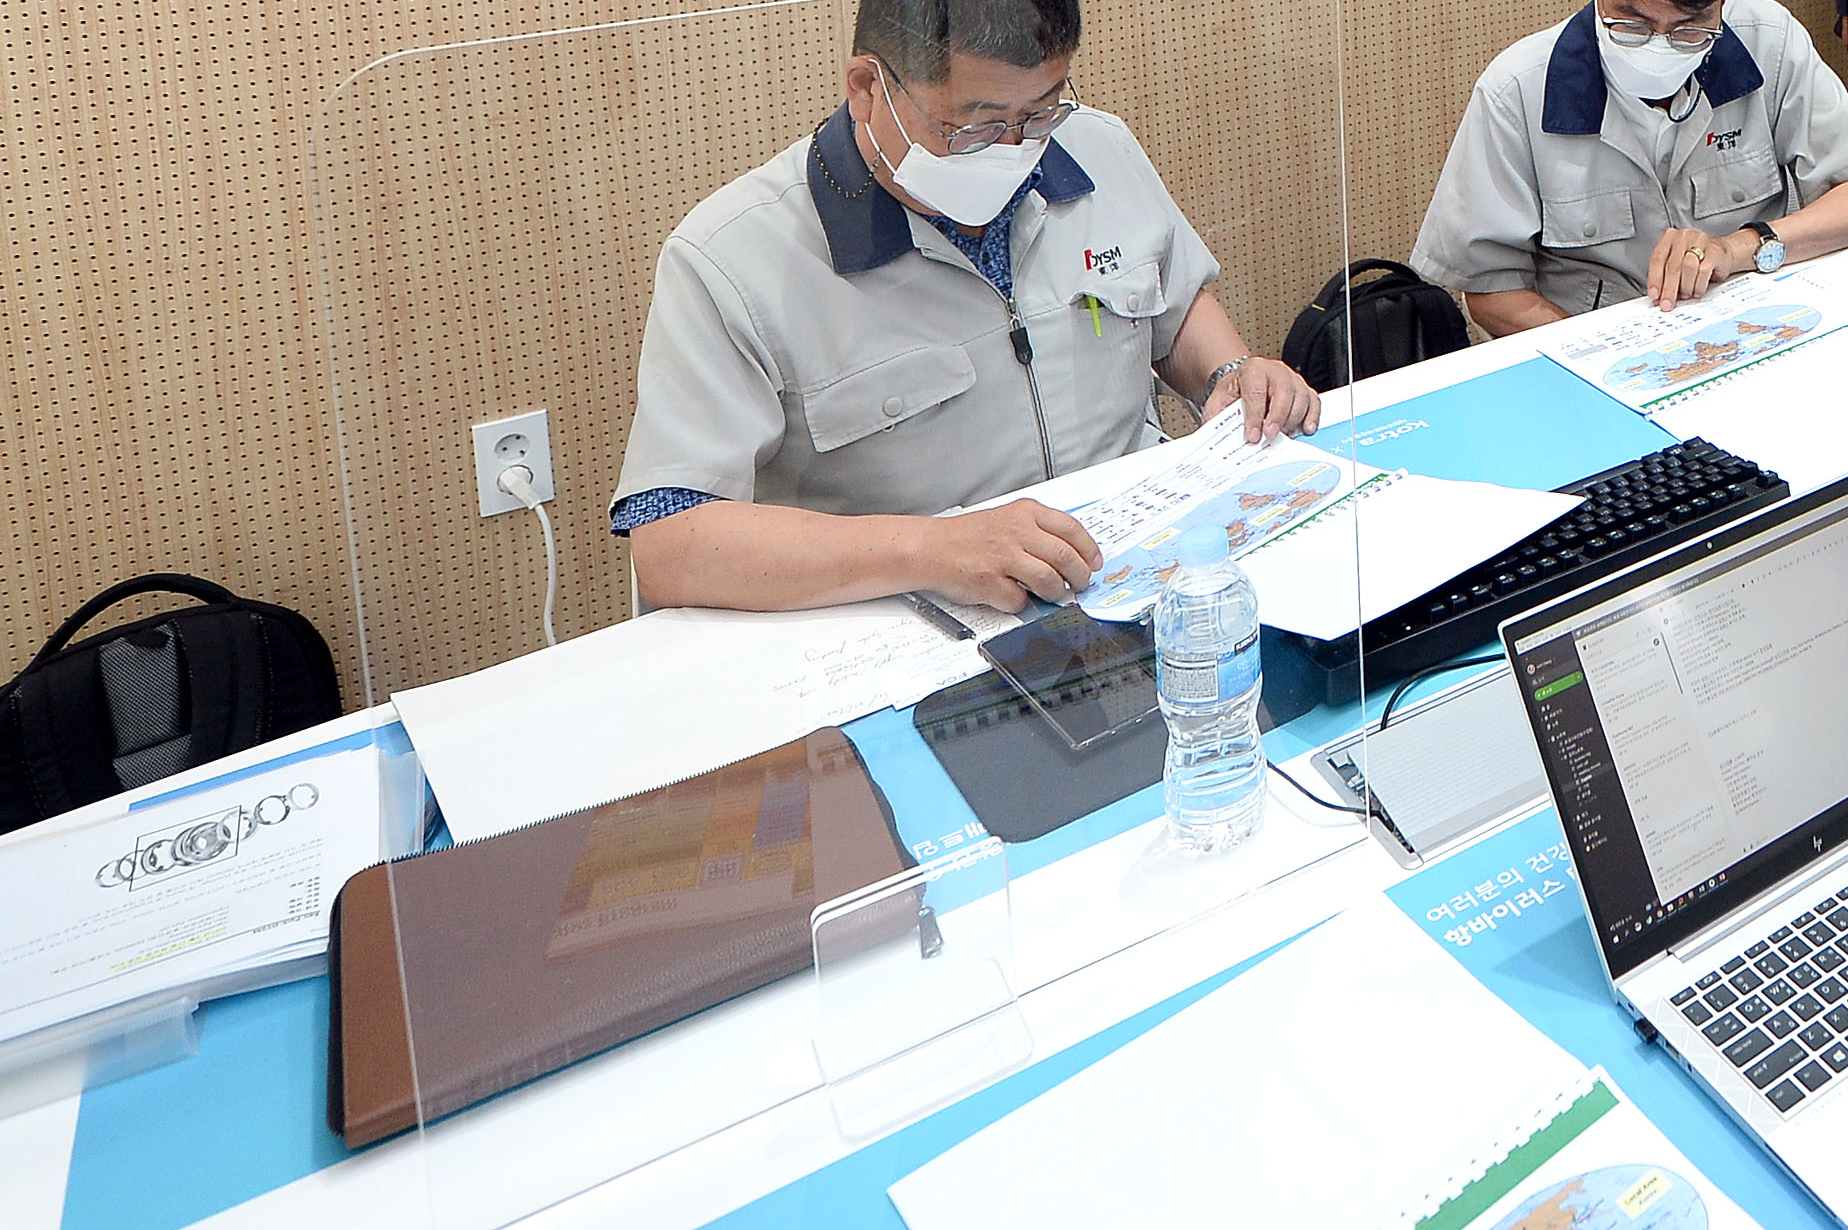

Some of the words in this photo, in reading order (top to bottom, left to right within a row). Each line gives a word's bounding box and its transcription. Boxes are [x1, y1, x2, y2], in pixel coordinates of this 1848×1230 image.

[1358, 419, 1430, 446] kotra
[1426, 867, 1525, 921] 여러분의
[1444, 879, 1566, 947] 항바이러스
